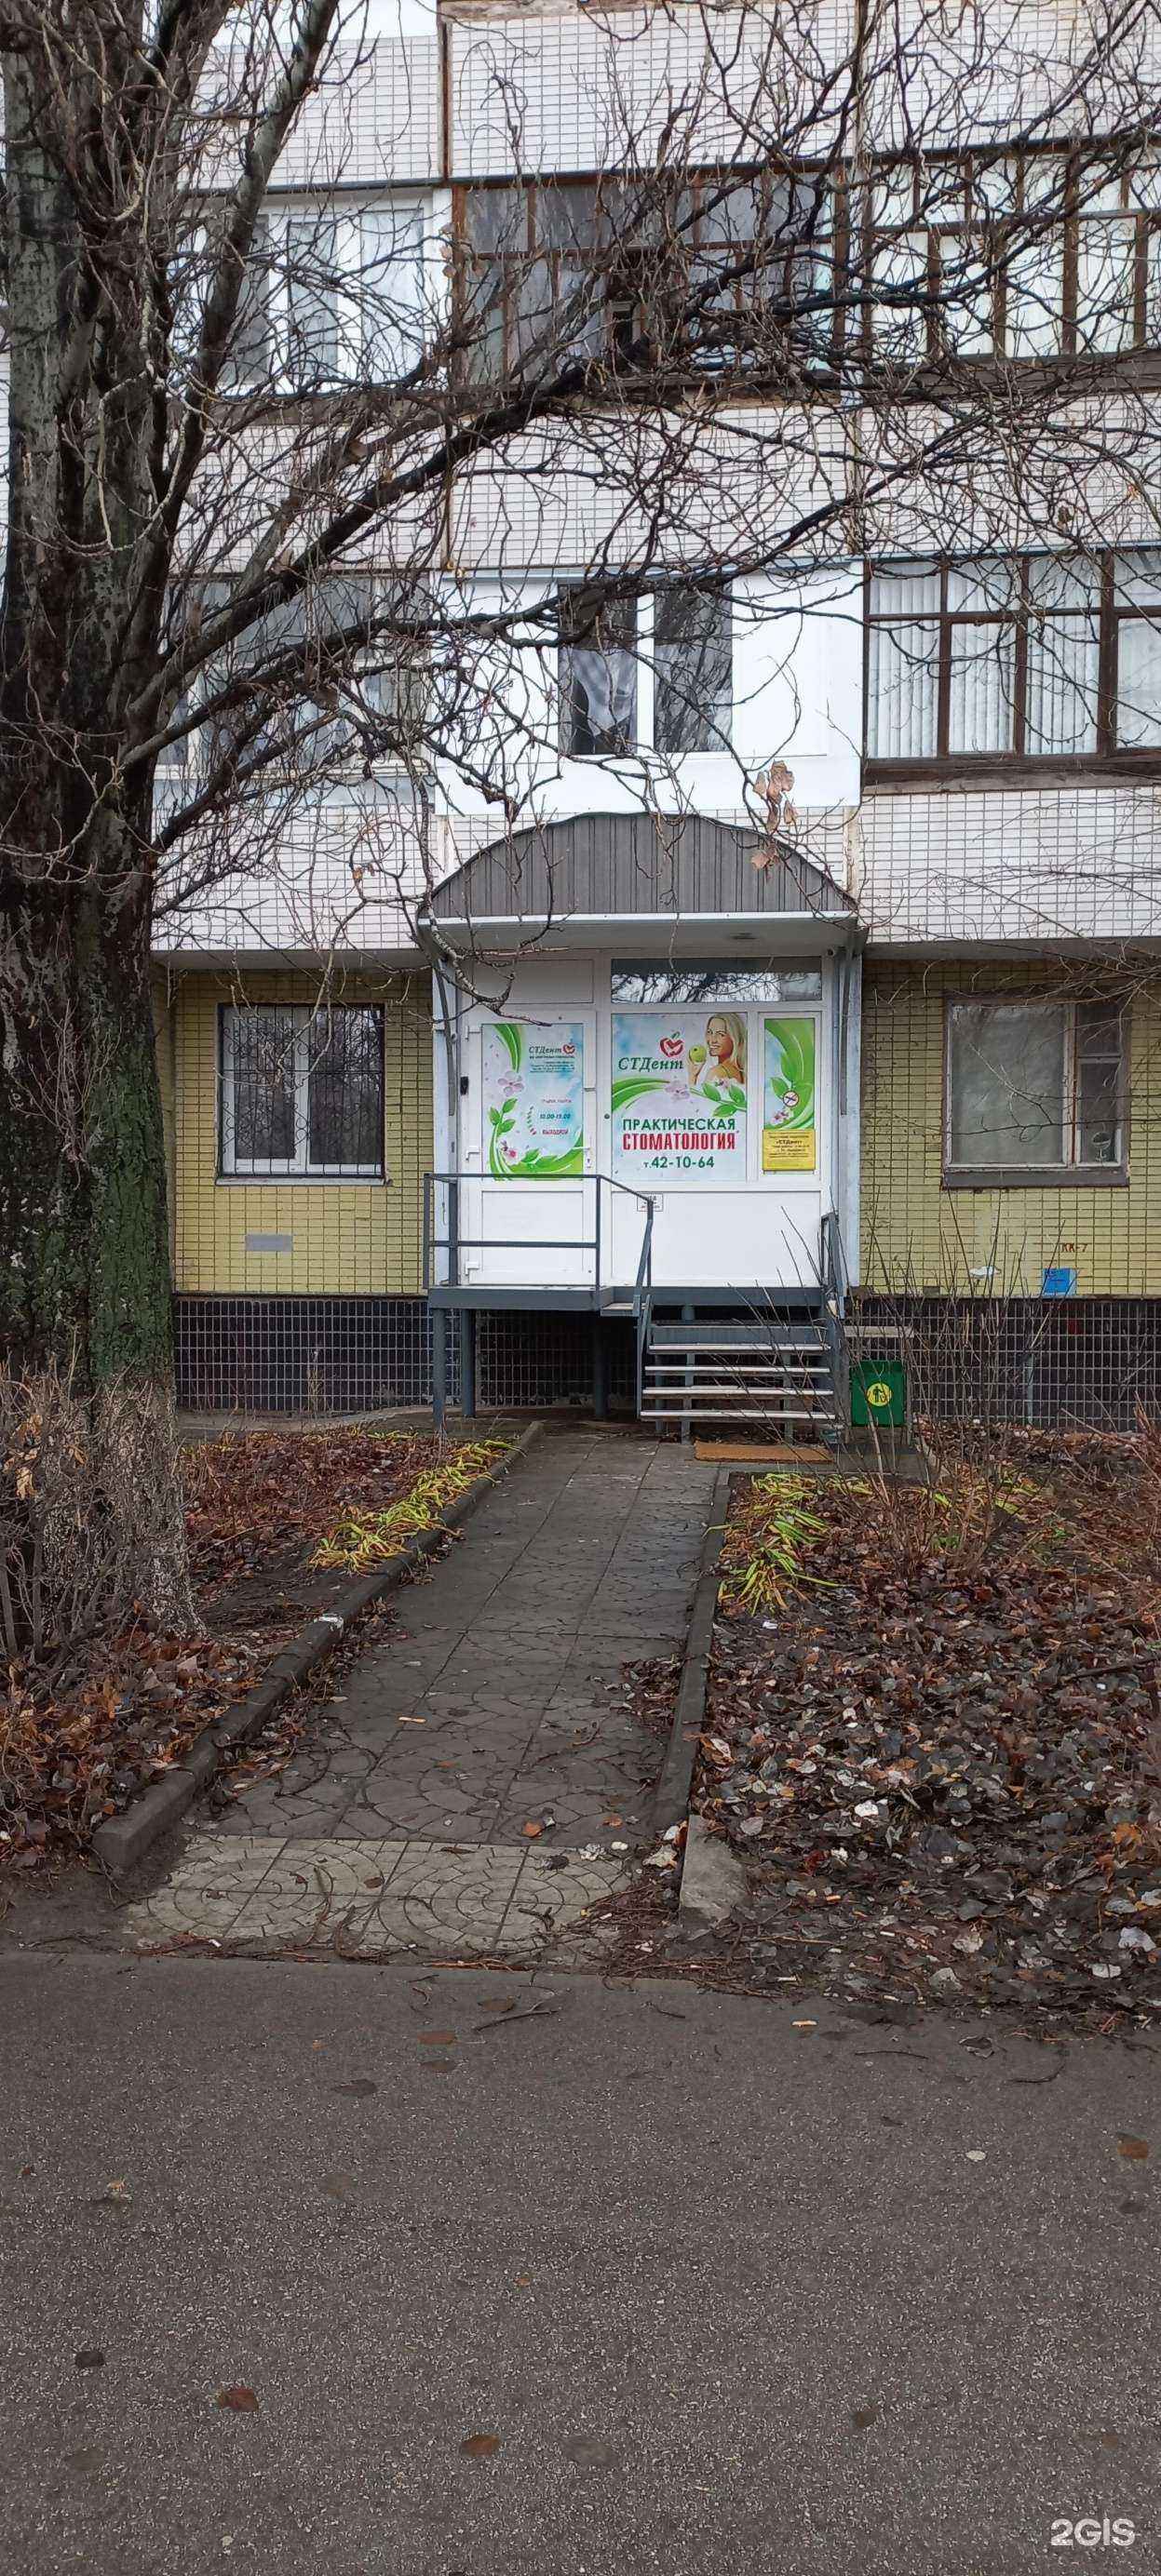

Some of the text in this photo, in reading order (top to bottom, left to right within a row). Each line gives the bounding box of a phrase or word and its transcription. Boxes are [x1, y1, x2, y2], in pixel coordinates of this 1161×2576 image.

[529, 1045, 562, 1054] СТДент
[618, 1057, 683, 1072] СТДент
[623, 1119, 736, 1131] ПРАКТИЧЕСКАЯ
[623, 1133, 736, 1150] СТОМАТОЛОГИЯ
